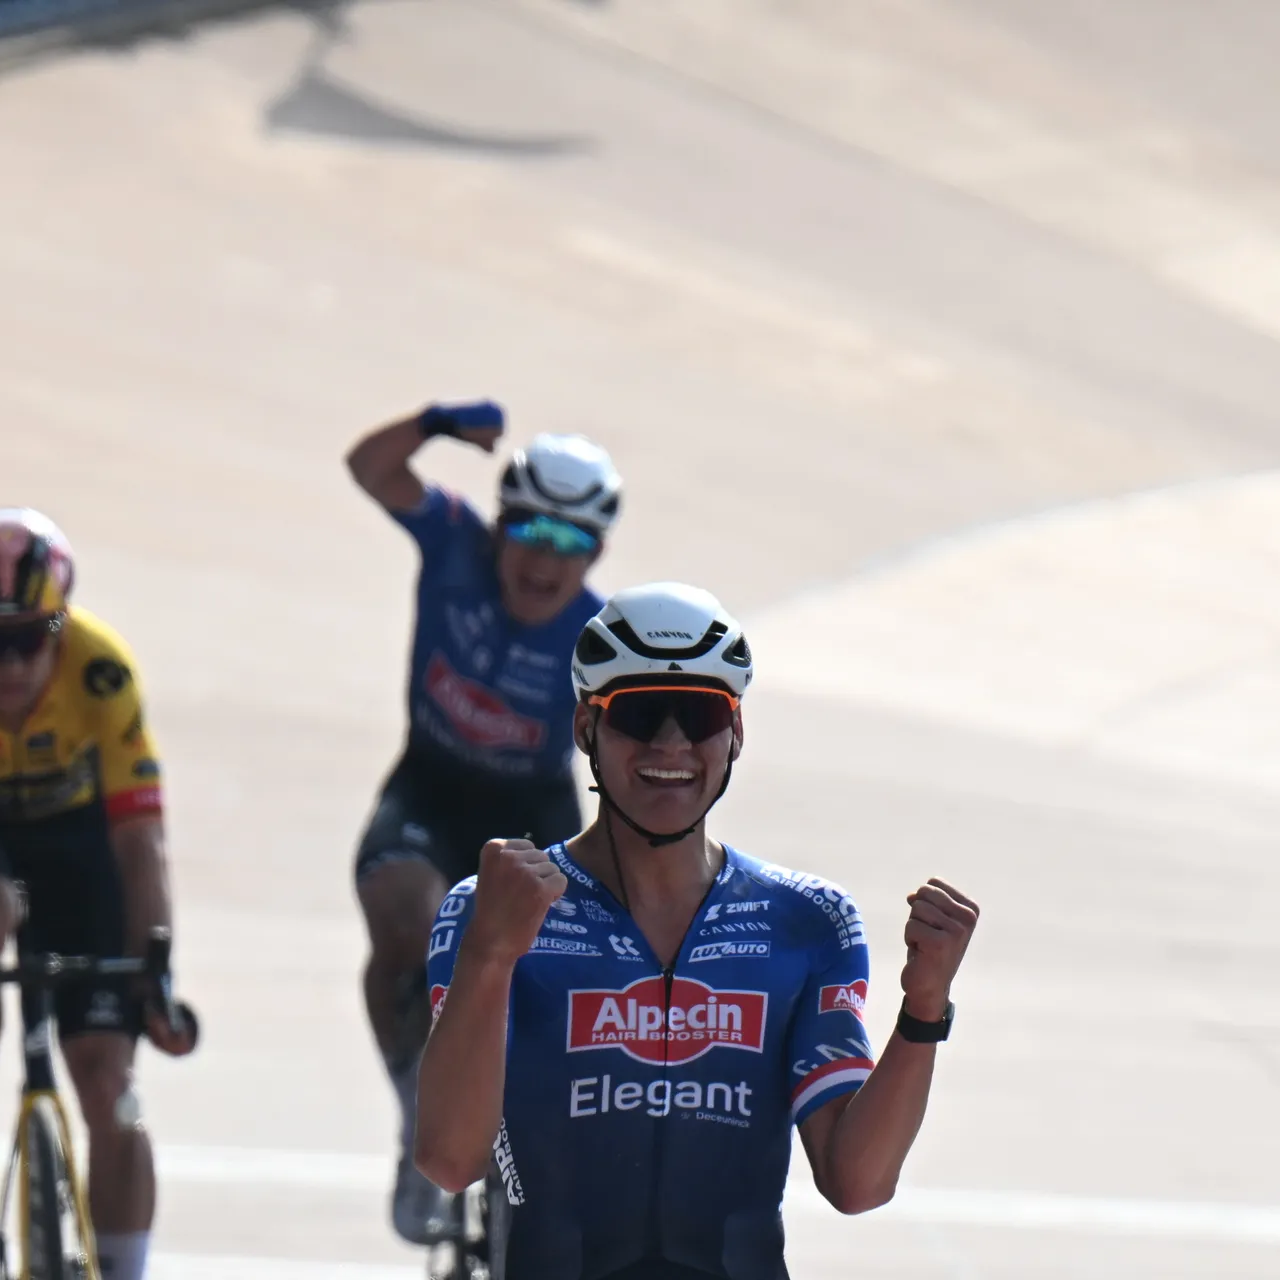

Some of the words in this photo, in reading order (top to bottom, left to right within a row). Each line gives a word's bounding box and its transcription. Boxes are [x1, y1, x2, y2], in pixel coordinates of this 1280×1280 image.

[646, 630, 693, 640] CANYON
[726, 900, 770, 914] ZWIFT
[803, 888, 850, 951] BOOSTER
[699, 921, 771, 936] CANYON
[592, 996, 742, 1040] Alpecin
[592, 1031, 637, 1042] HAIR
[649, 1030, 742, 1042] BOOSTER
[793, 1038, 873, 1076] CAN
[570, 1074, 752, 1118] Elegant
